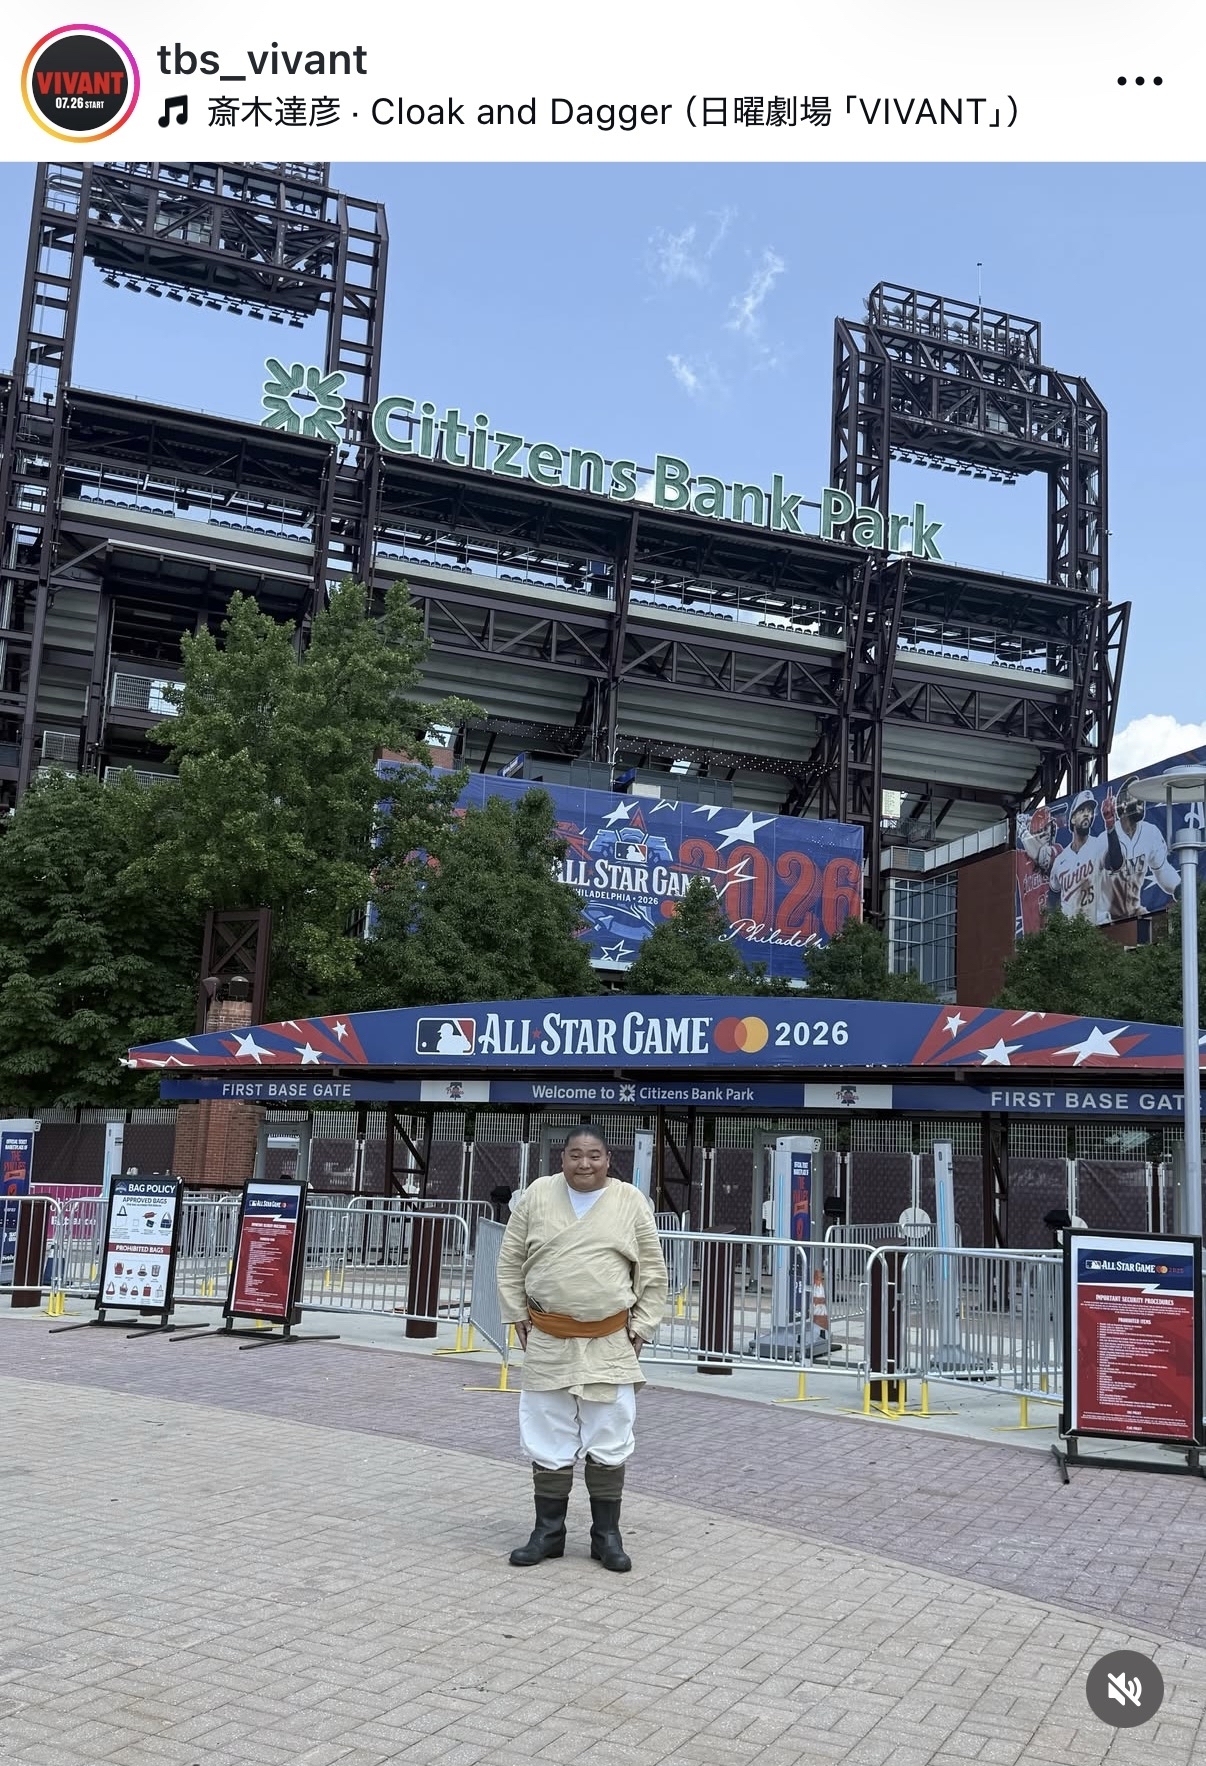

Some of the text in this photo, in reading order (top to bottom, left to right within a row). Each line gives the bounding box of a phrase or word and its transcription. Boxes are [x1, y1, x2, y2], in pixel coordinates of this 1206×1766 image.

[372, 397, 943, 560] Citizens Bank Park
[594, 859, 648, 893] STAR
[1059, 859, 1094, 898] Twins
[573, 887, 659, 905] HILADELPHIA 2026
[1080, 886, 1094, 907] 25
[478, 1011, 710, 1055] ALL STAR GAME
[775, 1021, 848, 1046] 2026
[223, 1084, 351, 1097] FIRST BASE GATE
[533, 1085, 754, 1101] Welcome to Citizens Bank Park
[992, 1092, 1202, 1110] FIRST BASE GAT
[128, 1184, 175, 1194] BAG POLICY
[122, 1196, 152, 1204] APPROVED
[1100, 1260, 1116, 1270] ALL
[1116, 1261, 1135, 1272] STAR
[1135, 1263, 1155, 1273] GAME
[1095, 1294, 1121, 1302] IMPORTANT
[1122, 1295, 1143, 1304] SECURITY
